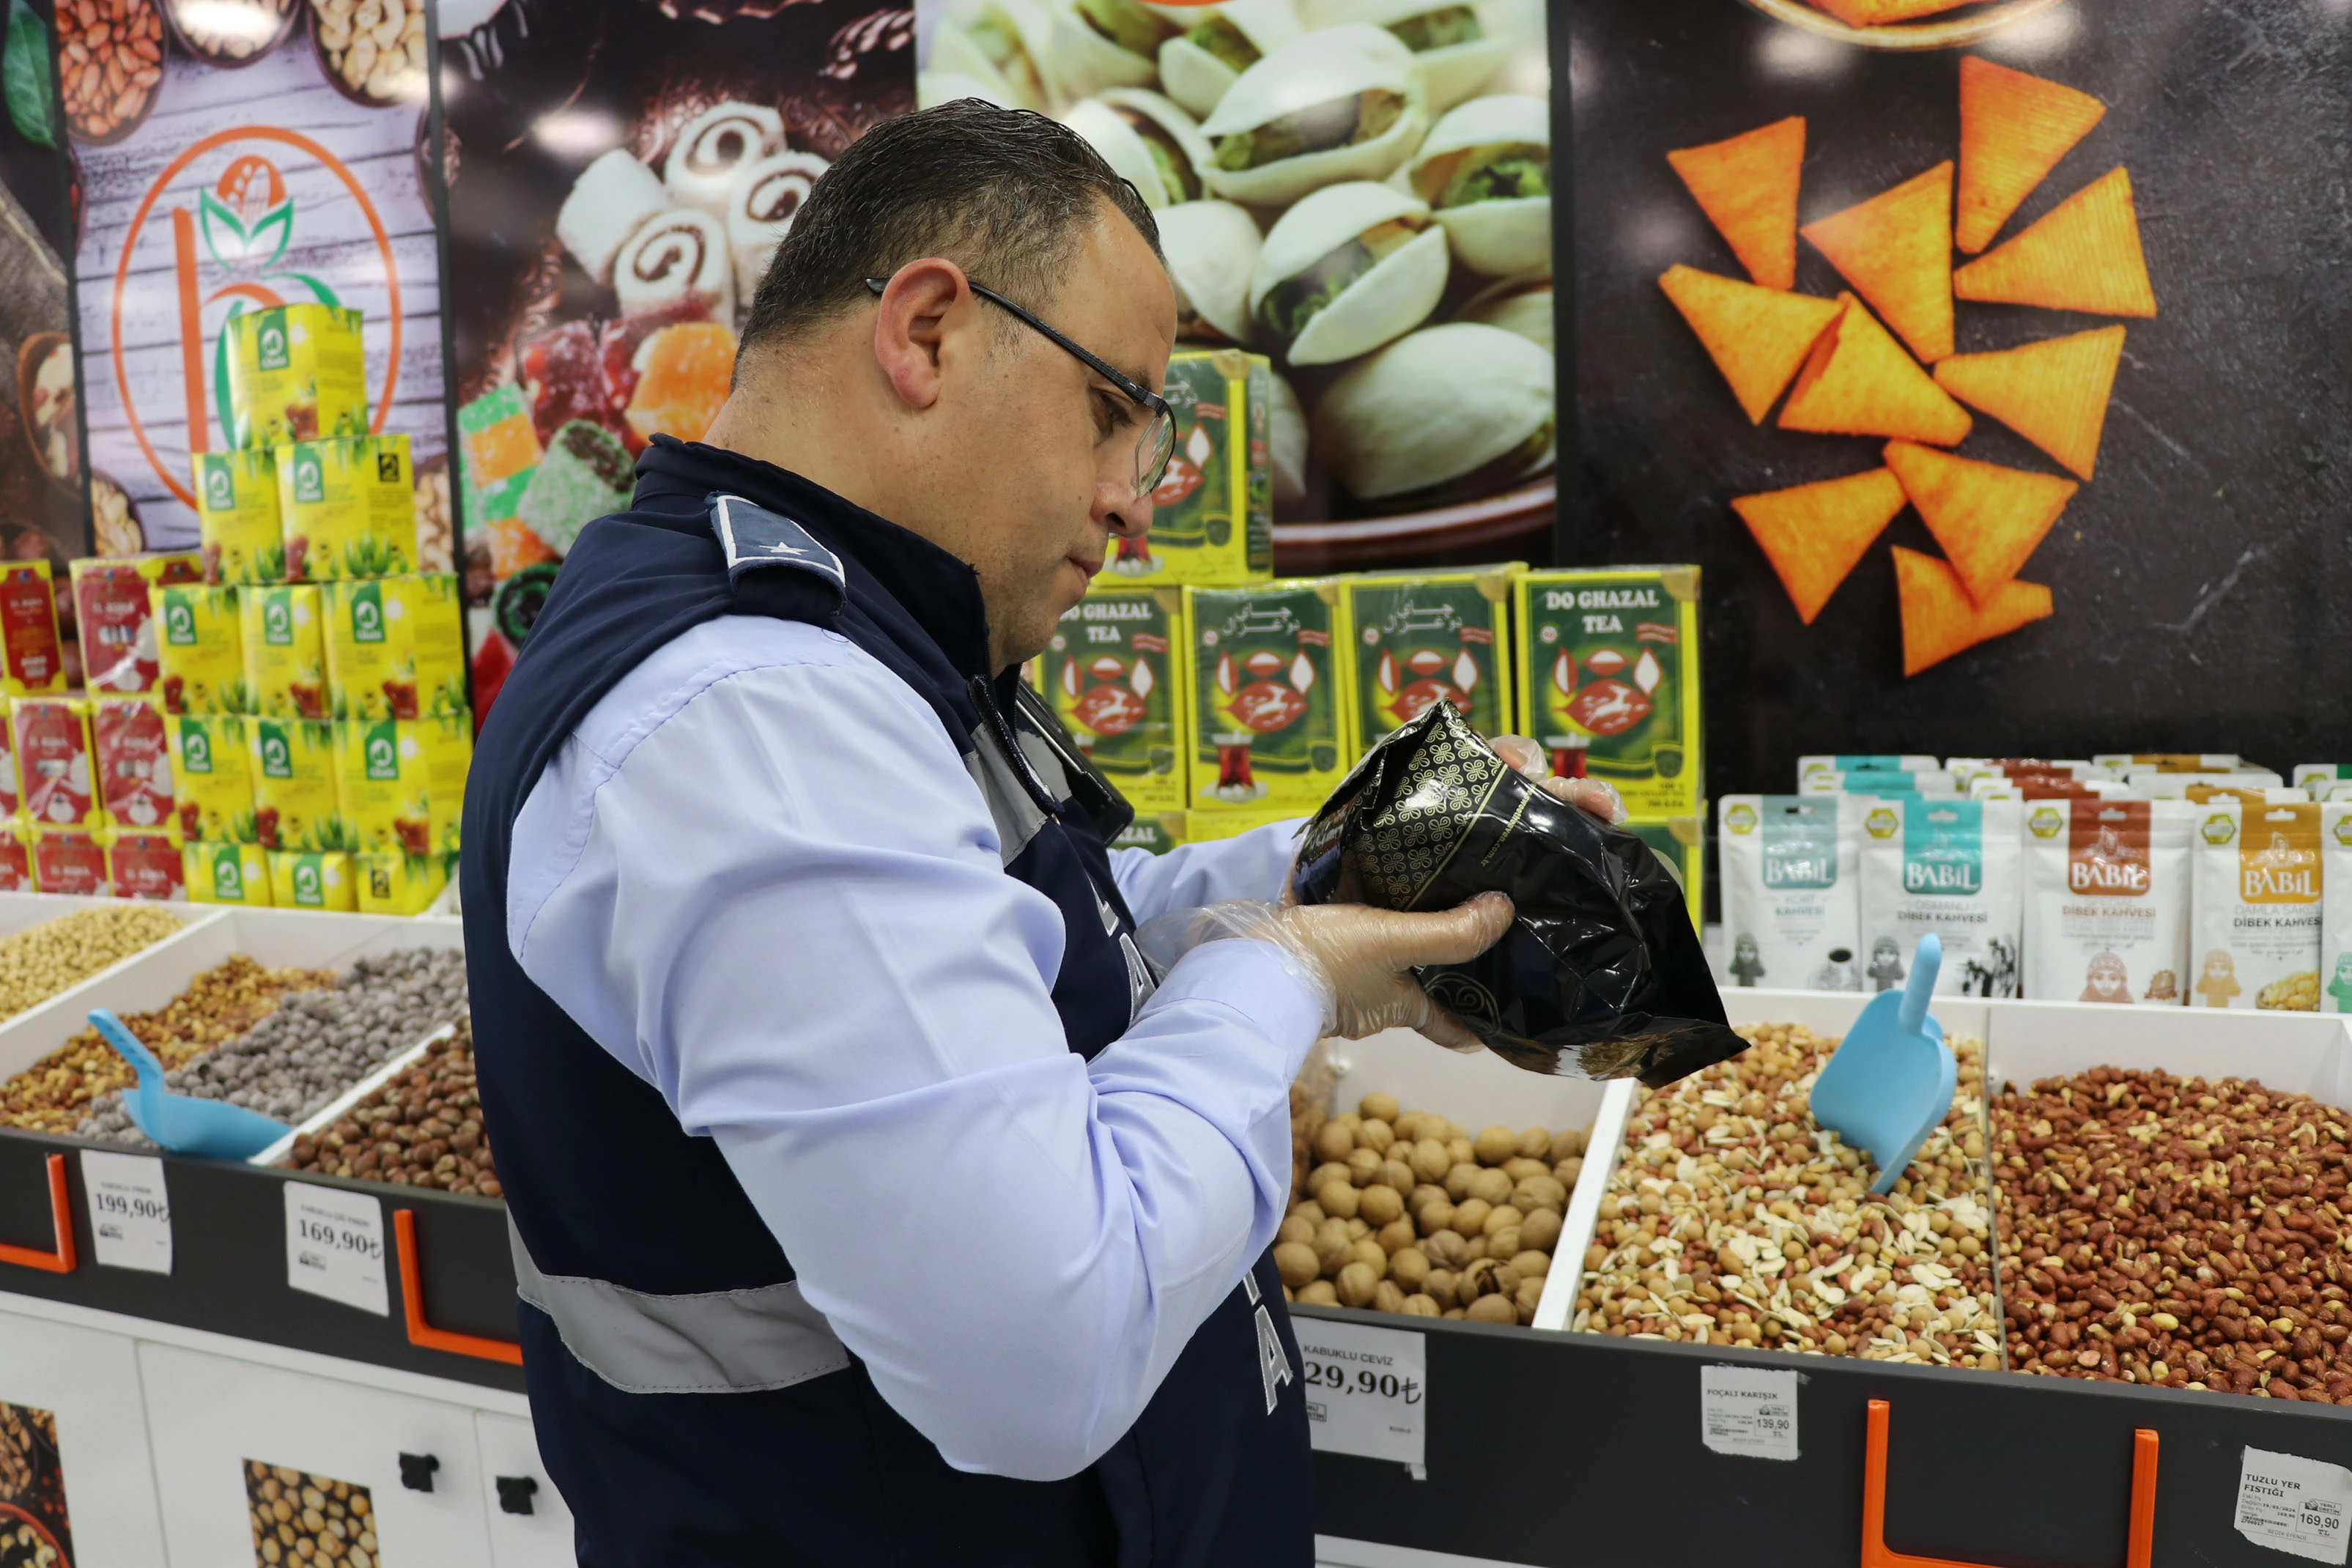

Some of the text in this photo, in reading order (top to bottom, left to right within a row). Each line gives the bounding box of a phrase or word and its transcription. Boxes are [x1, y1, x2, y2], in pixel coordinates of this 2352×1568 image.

[1546, 589, 1660, 610] DO GHAZAL
[1082, 602, 1153, 620] GHAZAL
[1582, 614, 1623, 633] TEA
[1086, 625, 1121, 642] TEA
[1303, 1345, 1394, 1367] KABUKLU CEVİZ
[1741, 1391, 1778, 1400] KARIŞIK
[1756, 1419, 1789, 1430] 139,90
[2246, 1473, 2301, 1490] TUZLU YER
[2244, 1484, 2285, 1497] FISTIĞI
[2300, 1513, 2340, 1529] 169,90
[2318, 1528, 2330, 1536] TL
